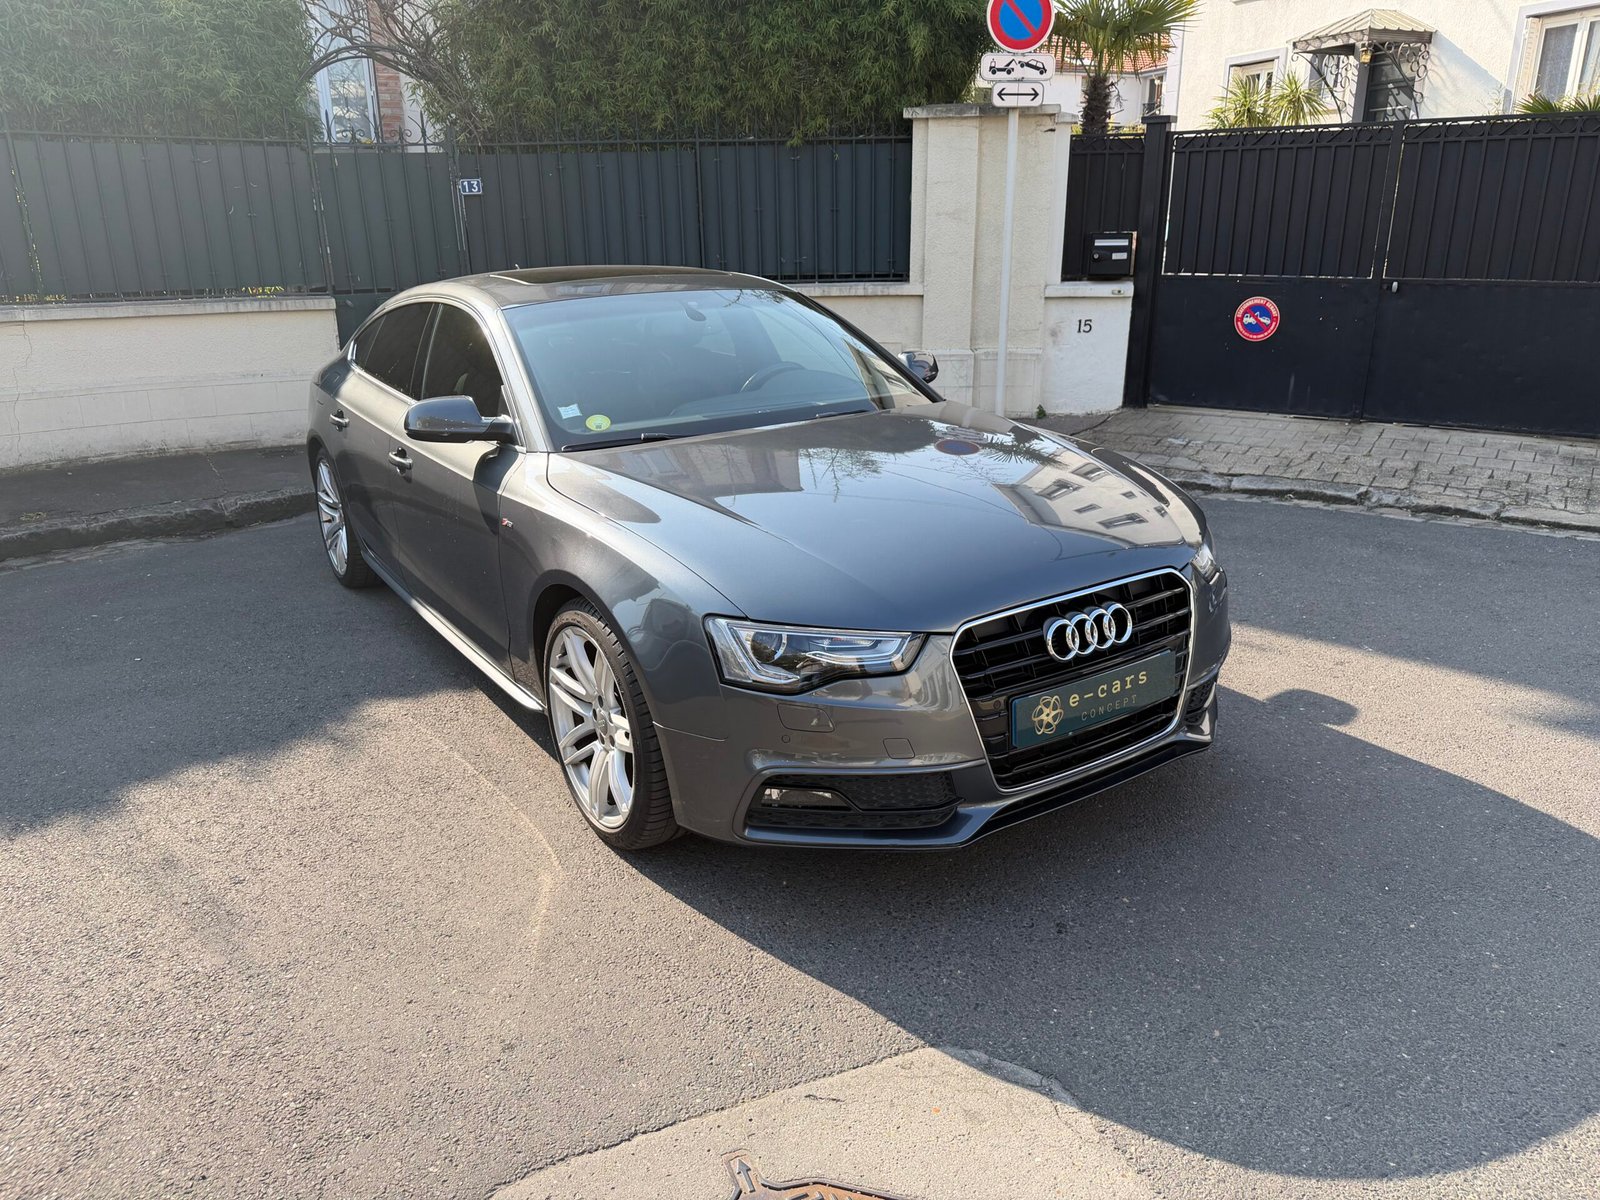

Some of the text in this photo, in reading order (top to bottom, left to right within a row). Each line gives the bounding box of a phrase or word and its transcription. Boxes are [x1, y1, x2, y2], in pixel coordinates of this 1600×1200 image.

[463, 181, 478, 193] 13
[1077, 319, 1093, 334] 15
[1069, 671, 1147, 707] e-cars
[1081, 695, 1137, 720] CONCEPT
